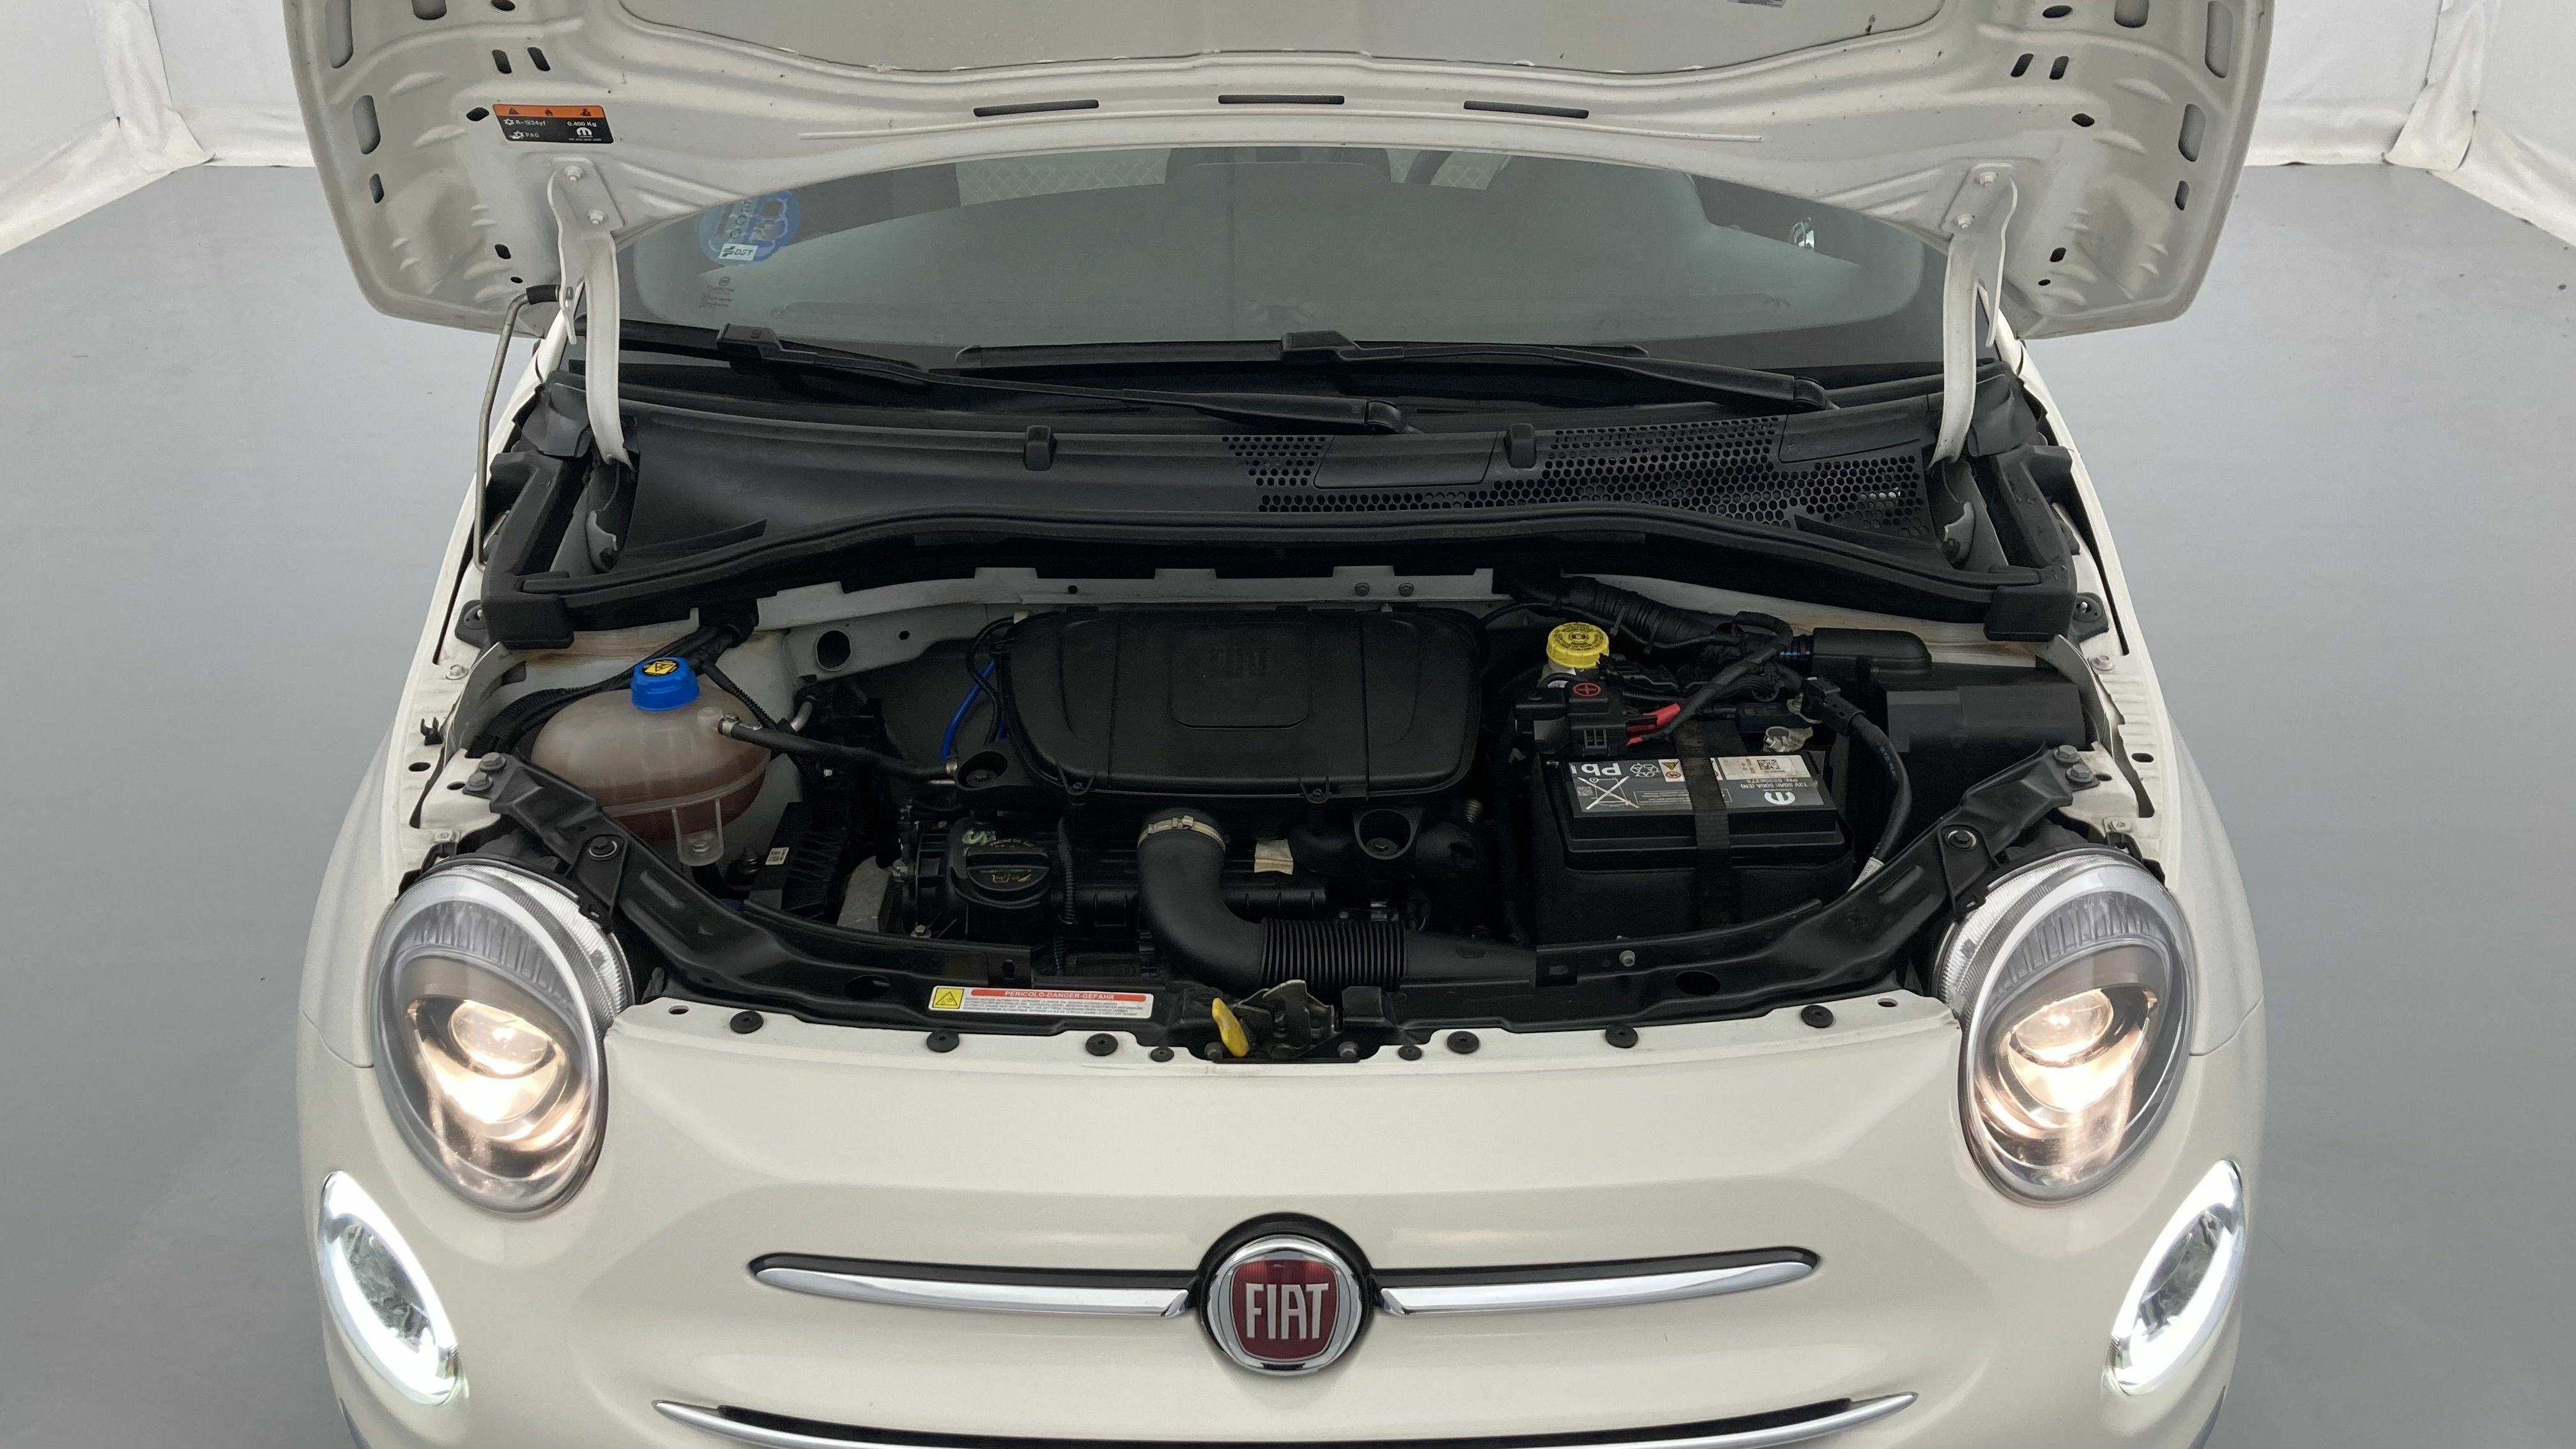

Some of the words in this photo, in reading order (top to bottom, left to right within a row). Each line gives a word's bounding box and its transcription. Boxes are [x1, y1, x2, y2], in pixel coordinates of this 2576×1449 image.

[734, 248, 754, 256] DGT
[1581, 762, 1621, 777] Pb
[1246, 1282, 1329, 1340] FIAT
